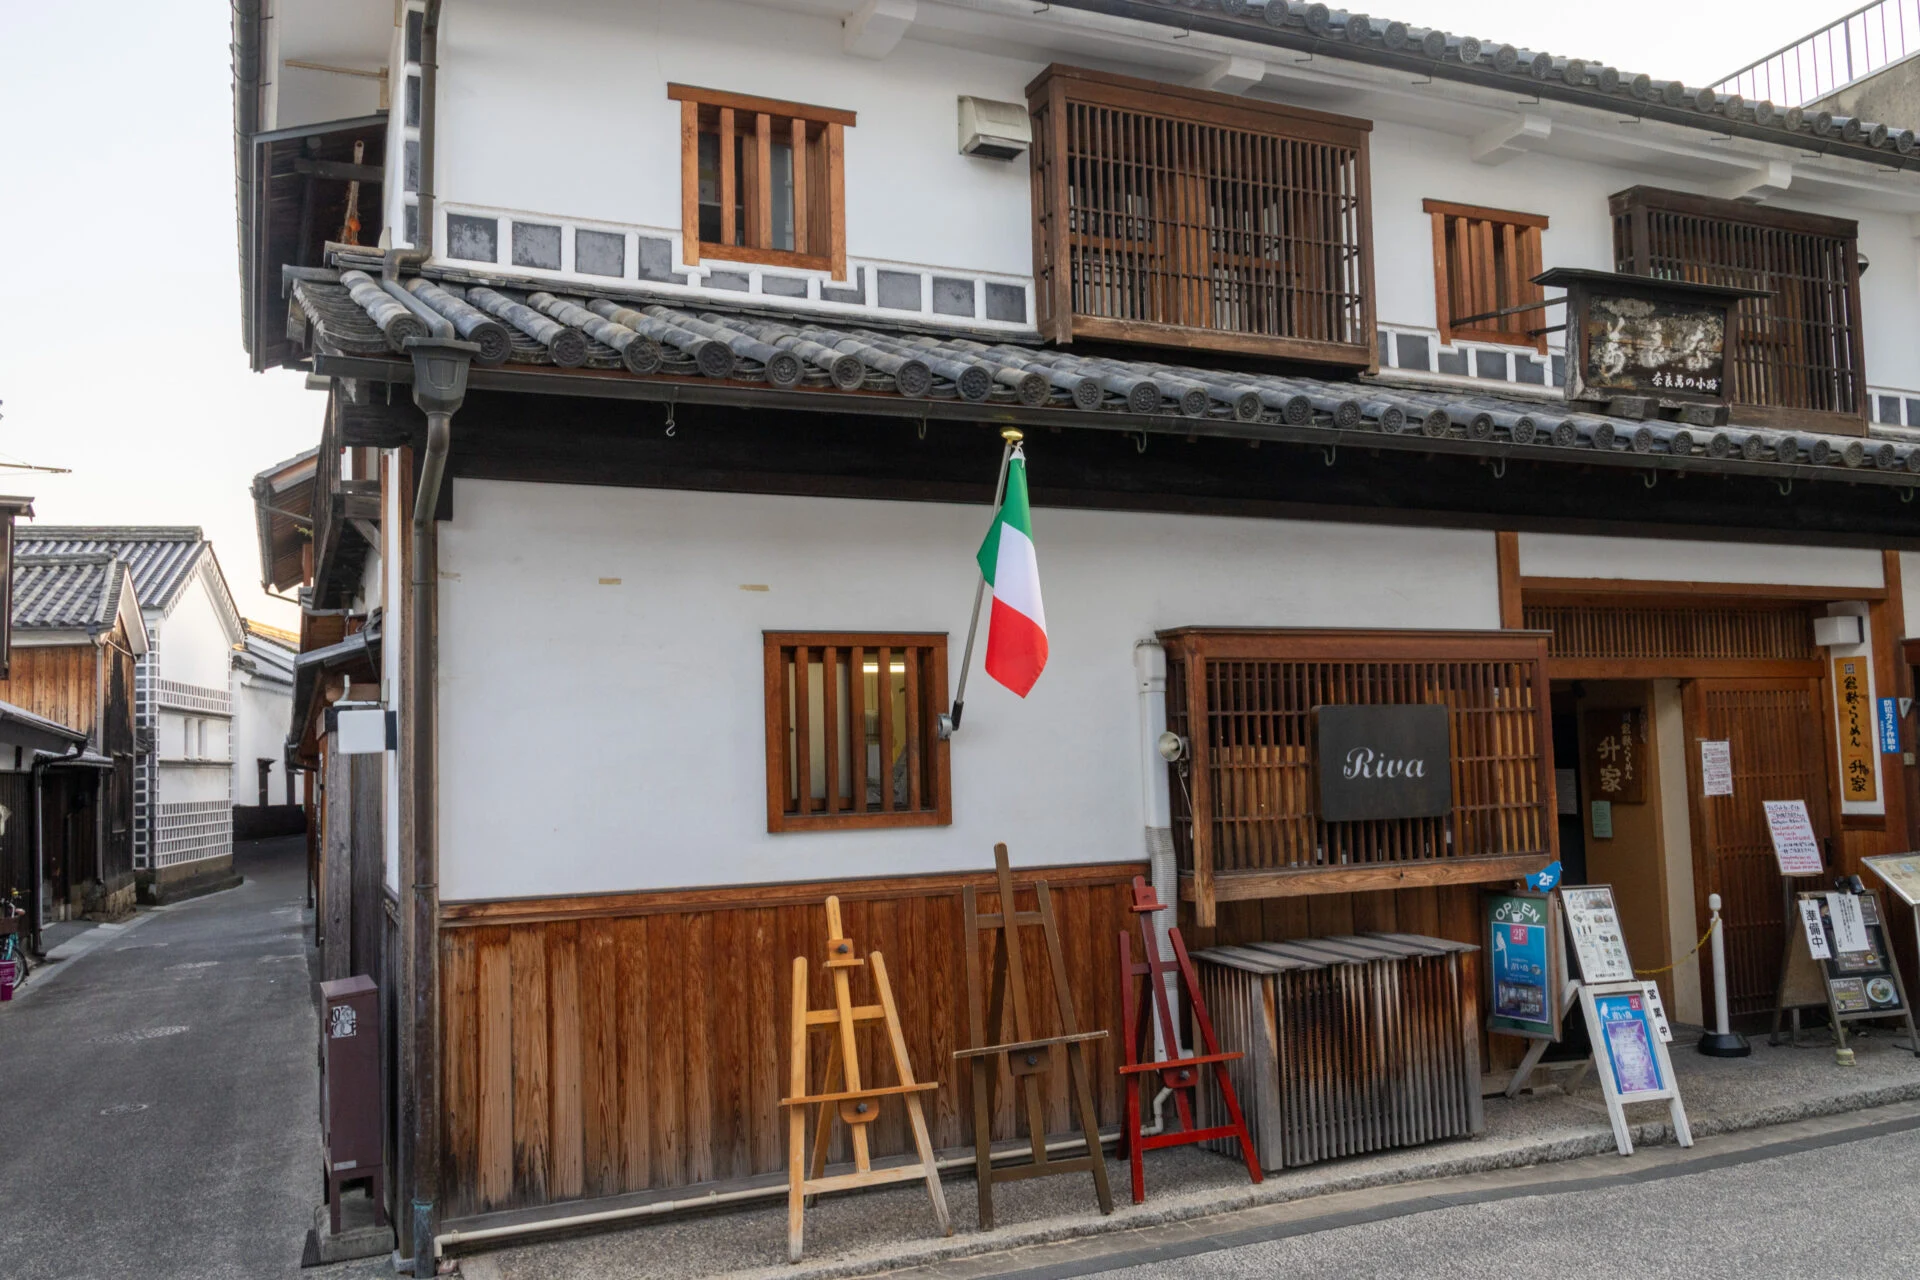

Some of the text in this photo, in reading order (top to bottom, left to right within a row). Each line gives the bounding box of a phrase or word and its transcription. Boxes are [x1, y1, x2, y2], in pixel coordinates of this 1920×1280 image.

[1652, 371, 1718, 390] 奈良萬の小路
[1343, 747, 1426, 779] Riva
[1597, 735, 1622, 792] 升家
[1538, 872, 1554, 887] 2F
[1495, 902, 1541, 924] OPEN
[1512, 928, 1526, 941] 2F
[1806, 909, 1823, 949] 準備中
[1630, 998, 1640, 1009] 2F
[1647, 988, 1668, 1037] 営業中
